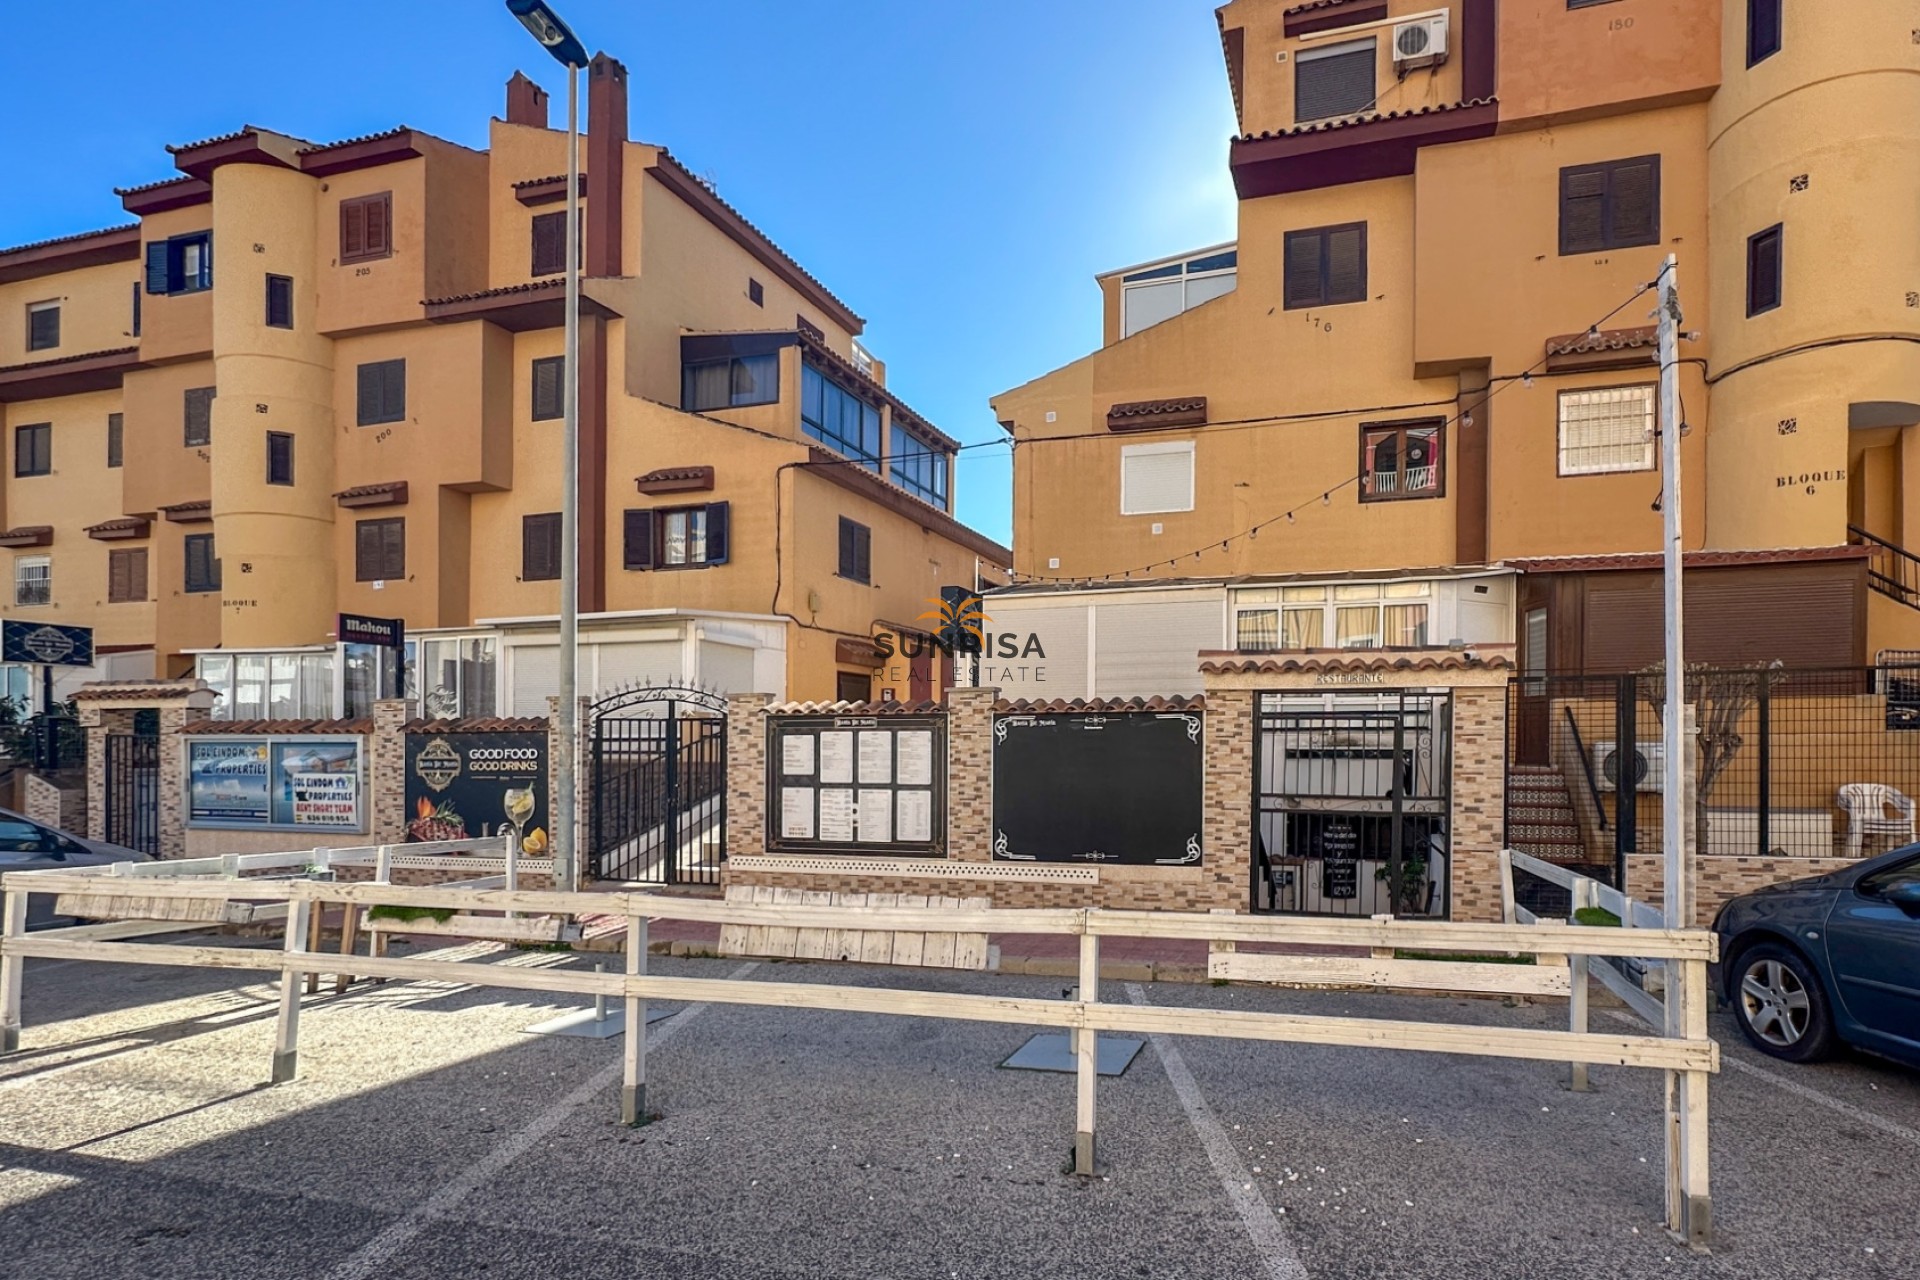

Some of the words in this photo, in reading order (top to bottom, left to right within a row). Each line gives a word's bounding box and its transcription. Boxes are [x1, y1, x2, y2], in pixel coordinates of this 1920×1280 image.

[1608, 17, 1634, 31] 180
[1305, 312, 1332, 332] 176
[376, 428, 391, 443] 200
[1776, 469, 1846, 487] BLOQUE
[1805, 485, 1815, 495] 6
[346, 619, 391, 635] Mahou
[196, 747, 210, 757] SOL
[469, 748, 504, 760] GOOD
[504, 748, 538, 760] FOOD
[215, 763, 267, 775] PROPERTIES
[469, 761, 500, 771] GOOD
[500, 761, 538, 771] DRINKS
[294, 777, 305, 787] SOL
[308, 791, 353, 801] PROPERTIES
[296, 803, 312, 812] RENT
[313, 804, 333, 813] SHORT
[334, 804, 353, 814] TERM
